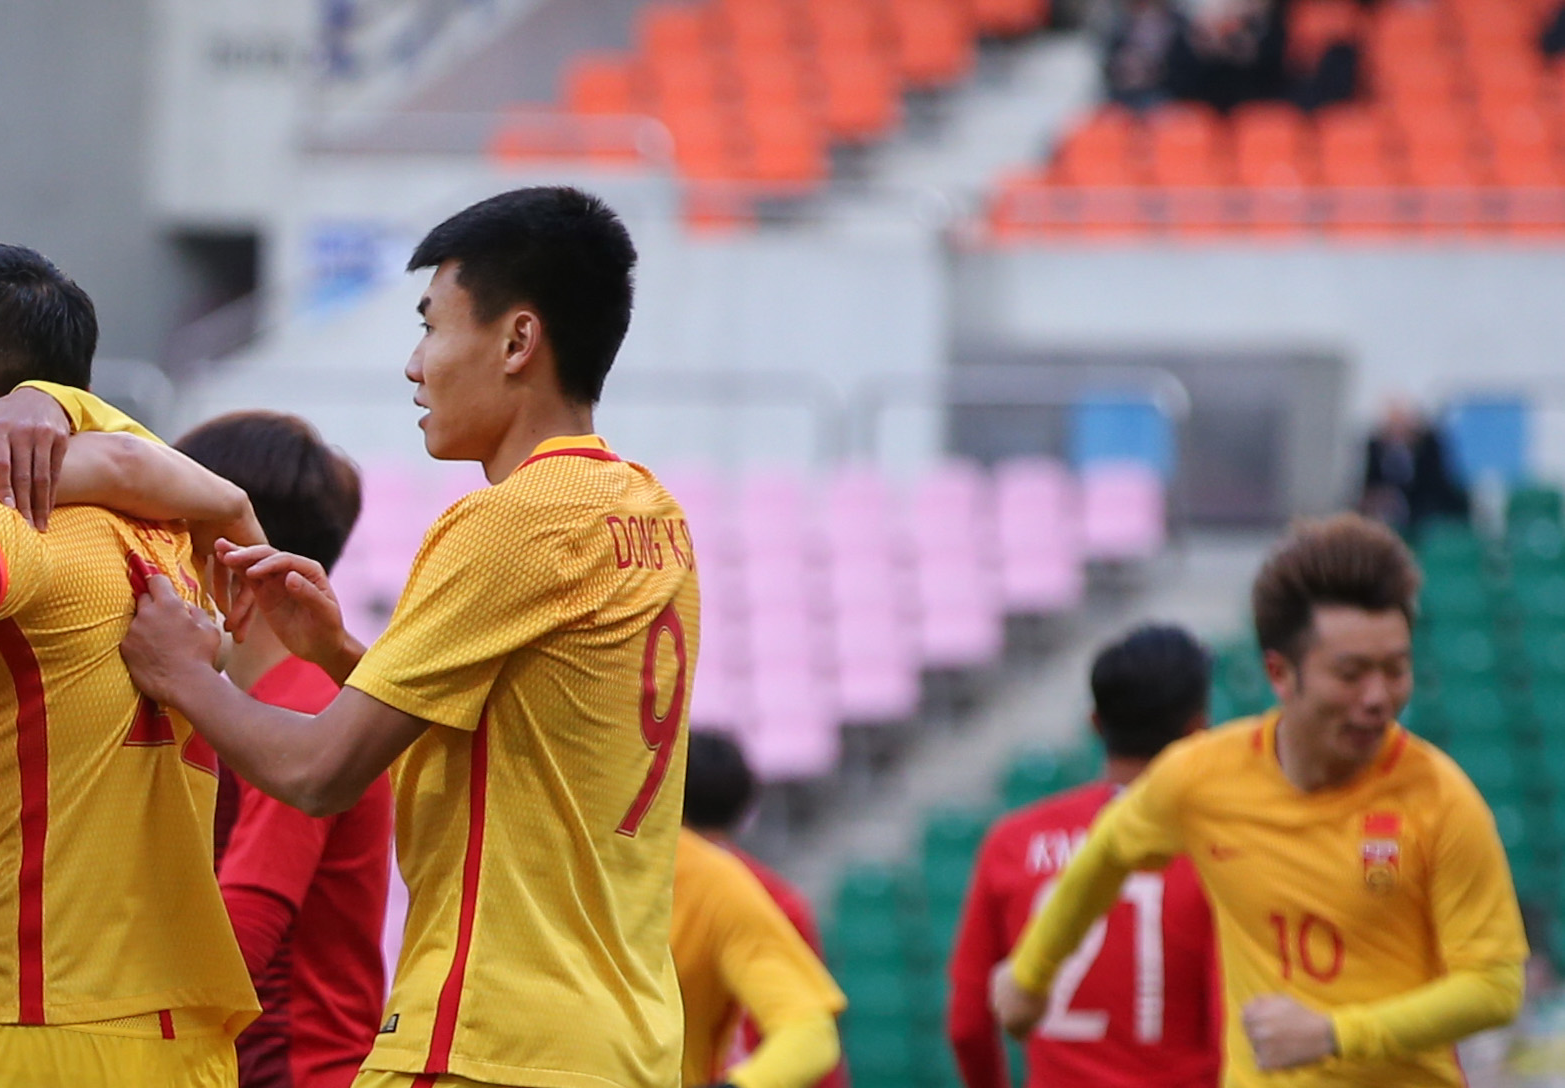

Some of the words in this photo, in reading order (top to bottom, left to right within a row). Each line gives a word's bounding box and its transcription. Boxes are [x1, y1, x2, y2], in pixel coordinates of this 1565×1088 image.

[606, 515, 663, 571] DONG
[615, 601, 687, 837] 9
[1270, 911, 1346, 984] 10
